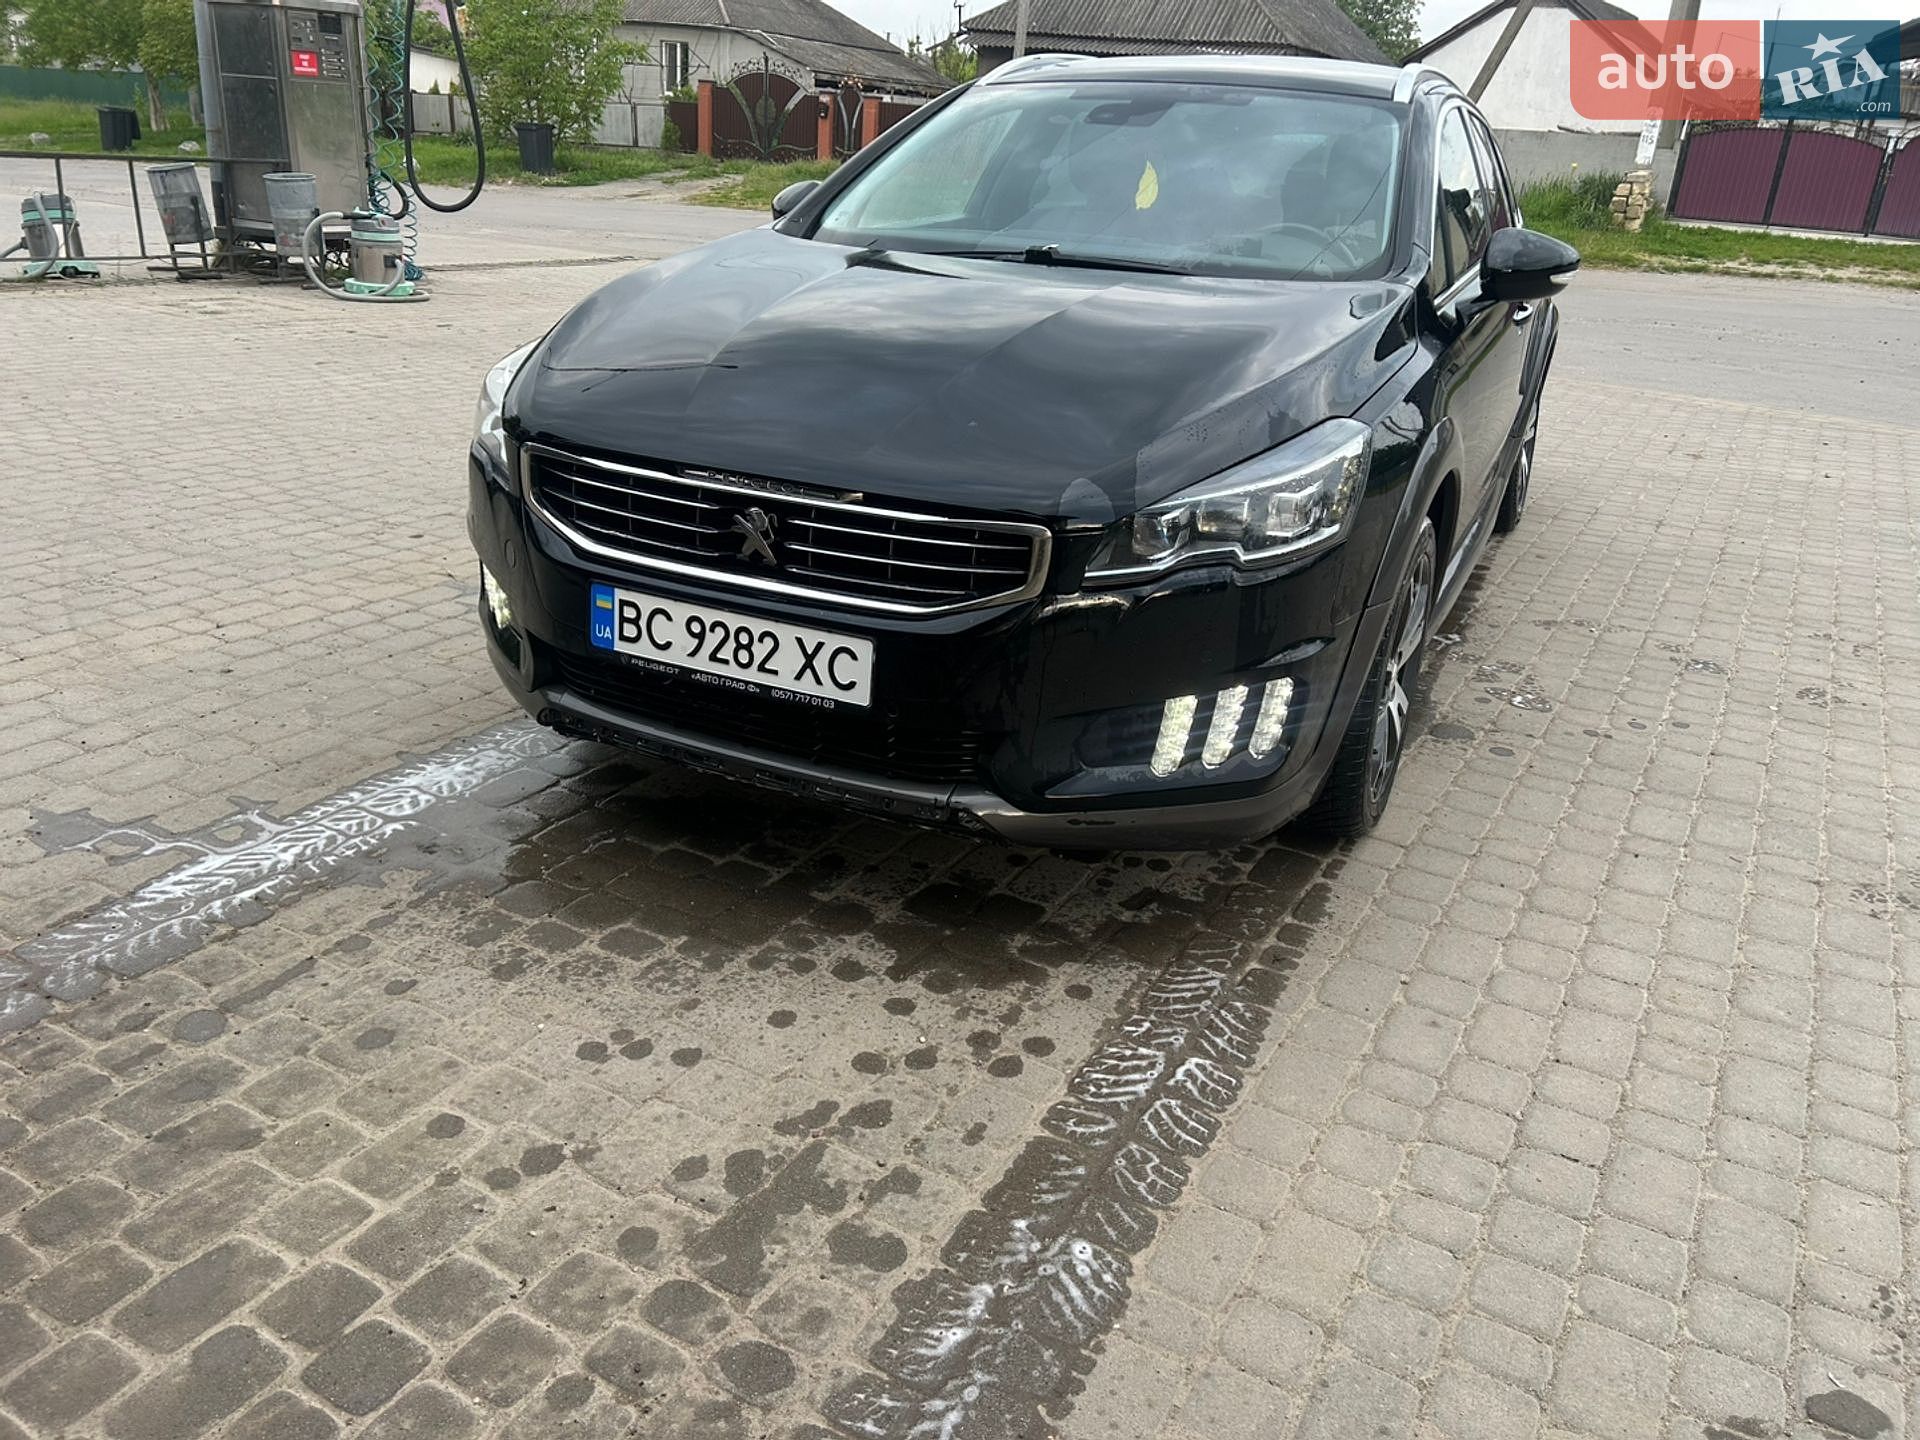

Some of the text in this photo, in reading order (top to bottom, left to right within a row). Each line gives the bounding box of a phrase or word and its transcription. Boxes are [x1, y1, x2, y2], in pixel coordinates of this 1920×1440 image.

[595, 623, 612, 640] UA
[618, 598, 858, 691] BC 9282 XC
[771, 688, 794, 701] (057)
[795, 693, 810, 704] 717
